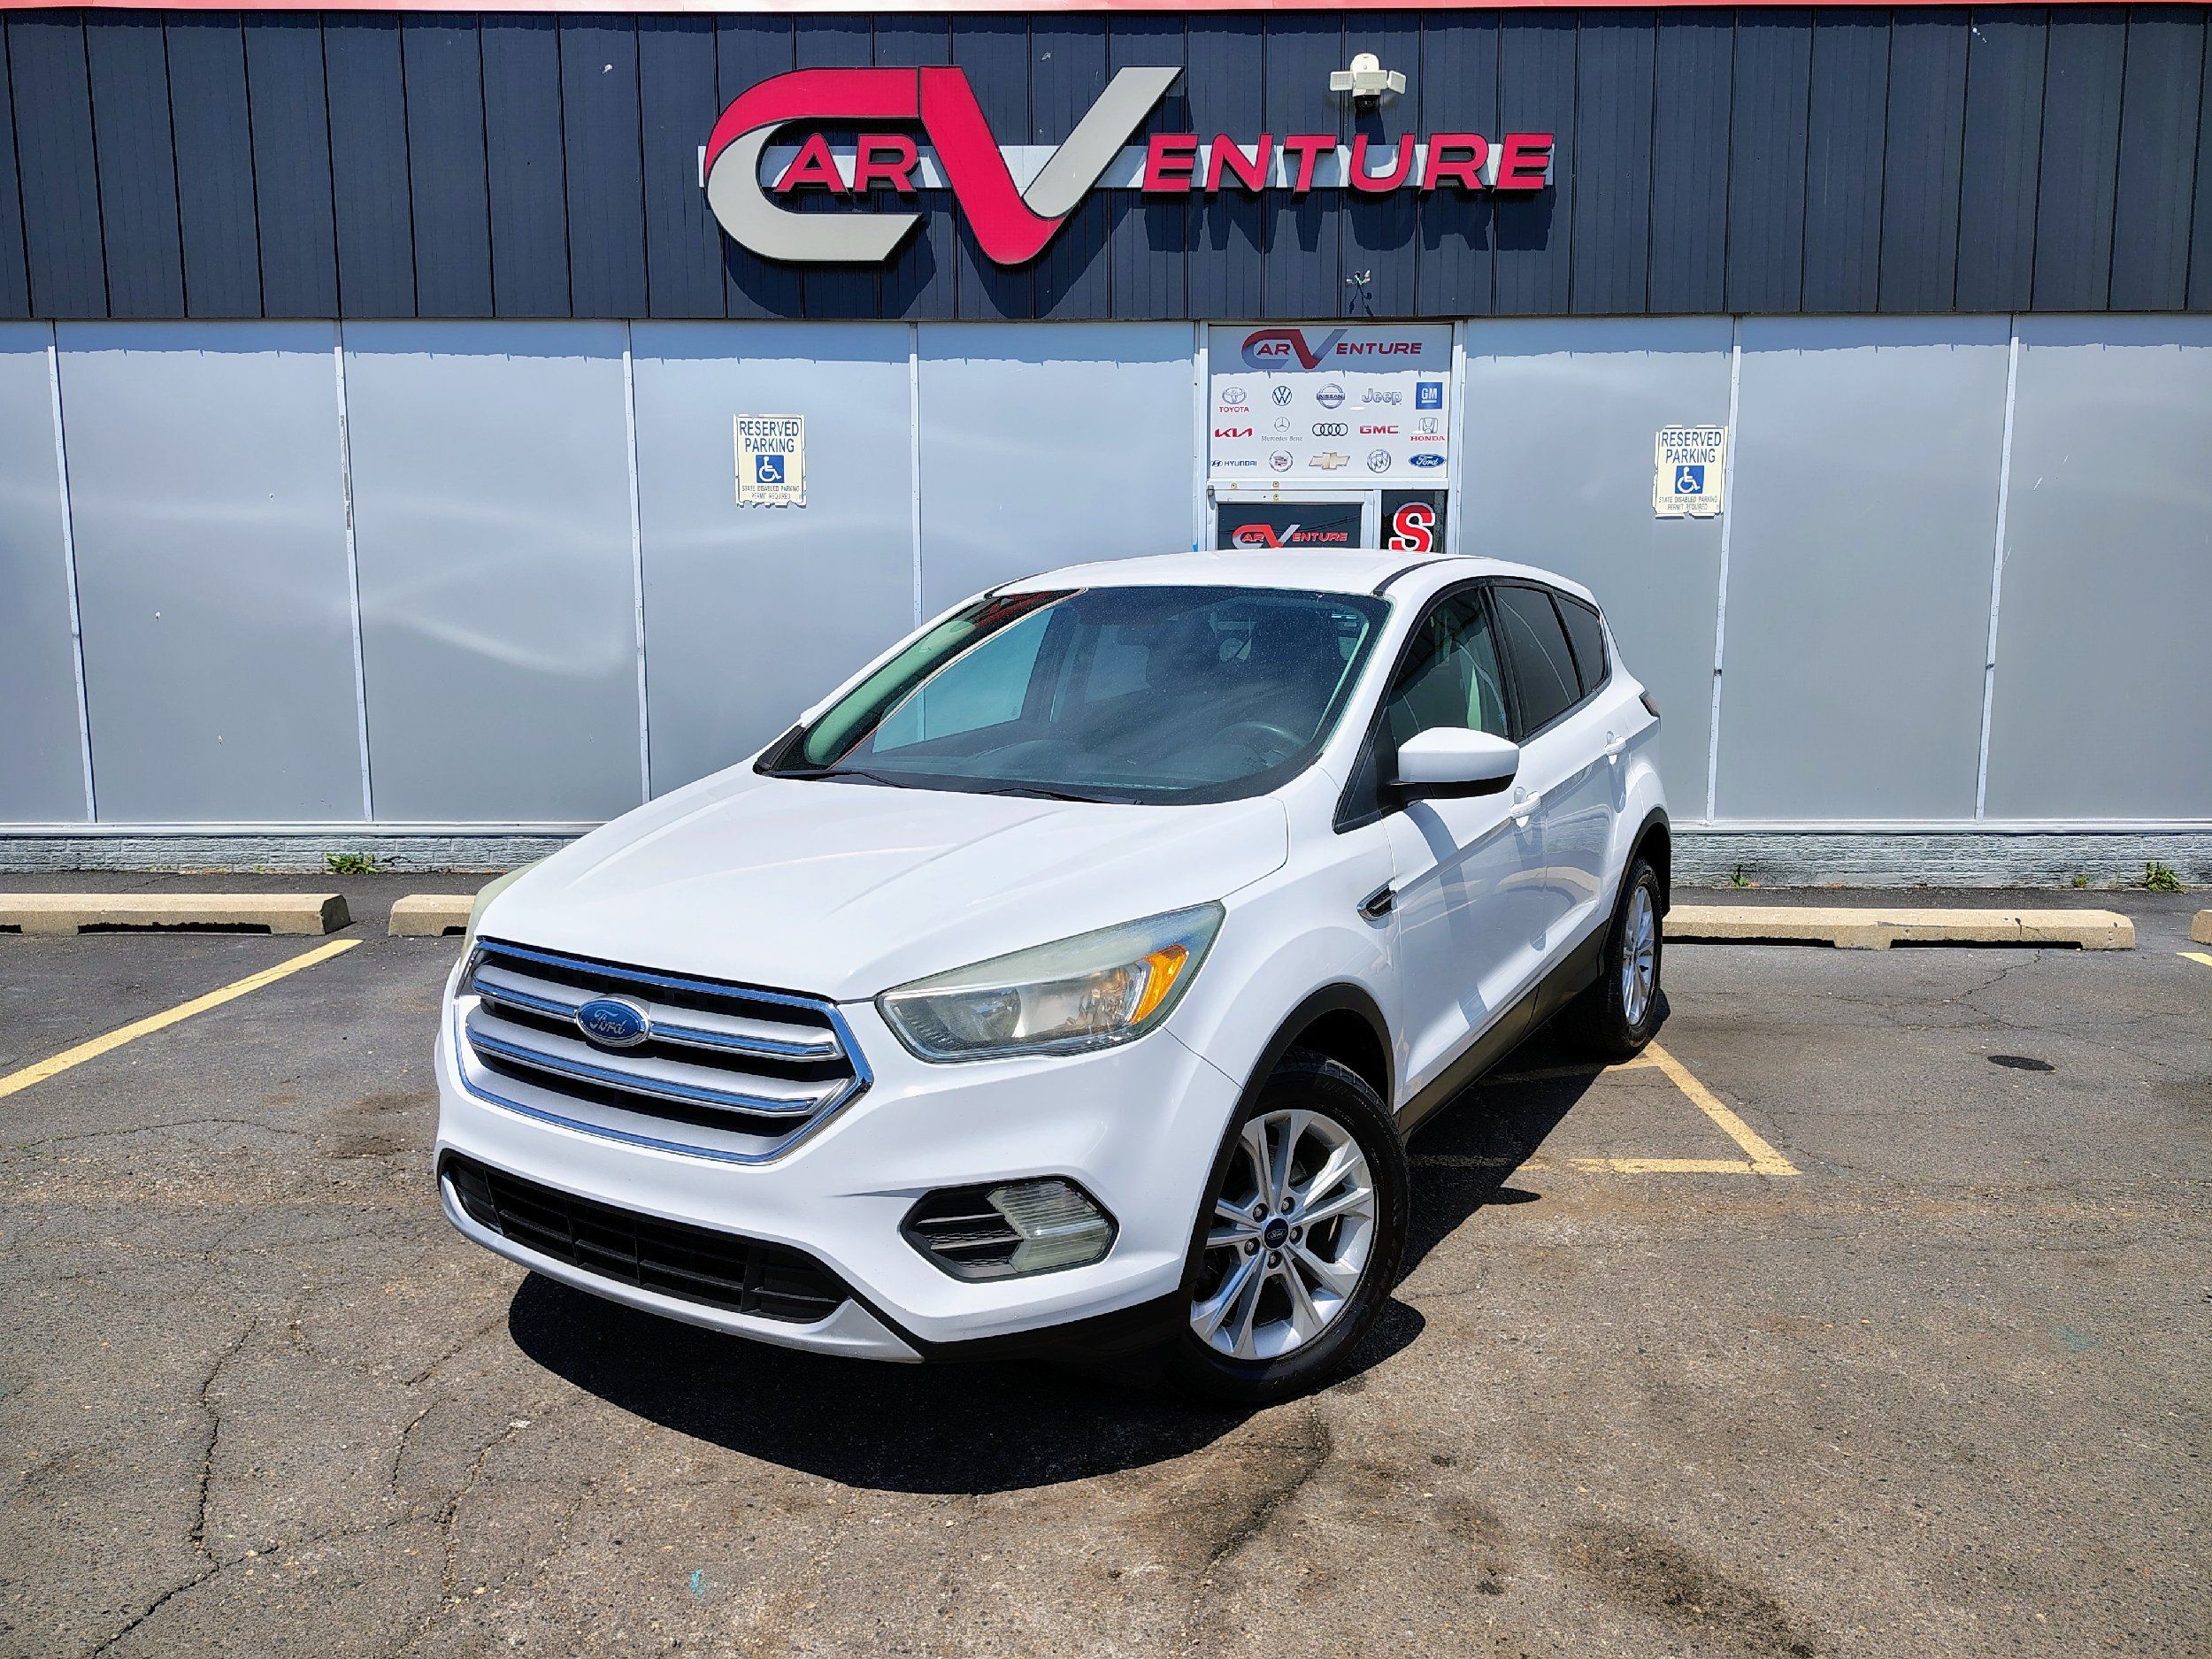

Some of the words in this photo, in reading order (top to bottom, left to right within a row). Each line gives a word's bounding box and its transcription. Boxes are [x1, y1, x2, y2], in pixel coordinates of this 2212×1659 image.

[1361, 388, 1402, 405] Jeep
[1421, 388, 1438, 399] GM
[740, 420, 799, 436] RESERVED
[1214, 427, 1253, 438] KIA
[1359, 425, 1400, 434] GMC
[745, 438, 795, 453] PARKING
[1661, 431, 1722, 448] RESERVED
[1416, 456, 1439, 467] Ford
[1665, 448, 1716, 465] PARKING
[589, 1009, 626, 1035] Ford
